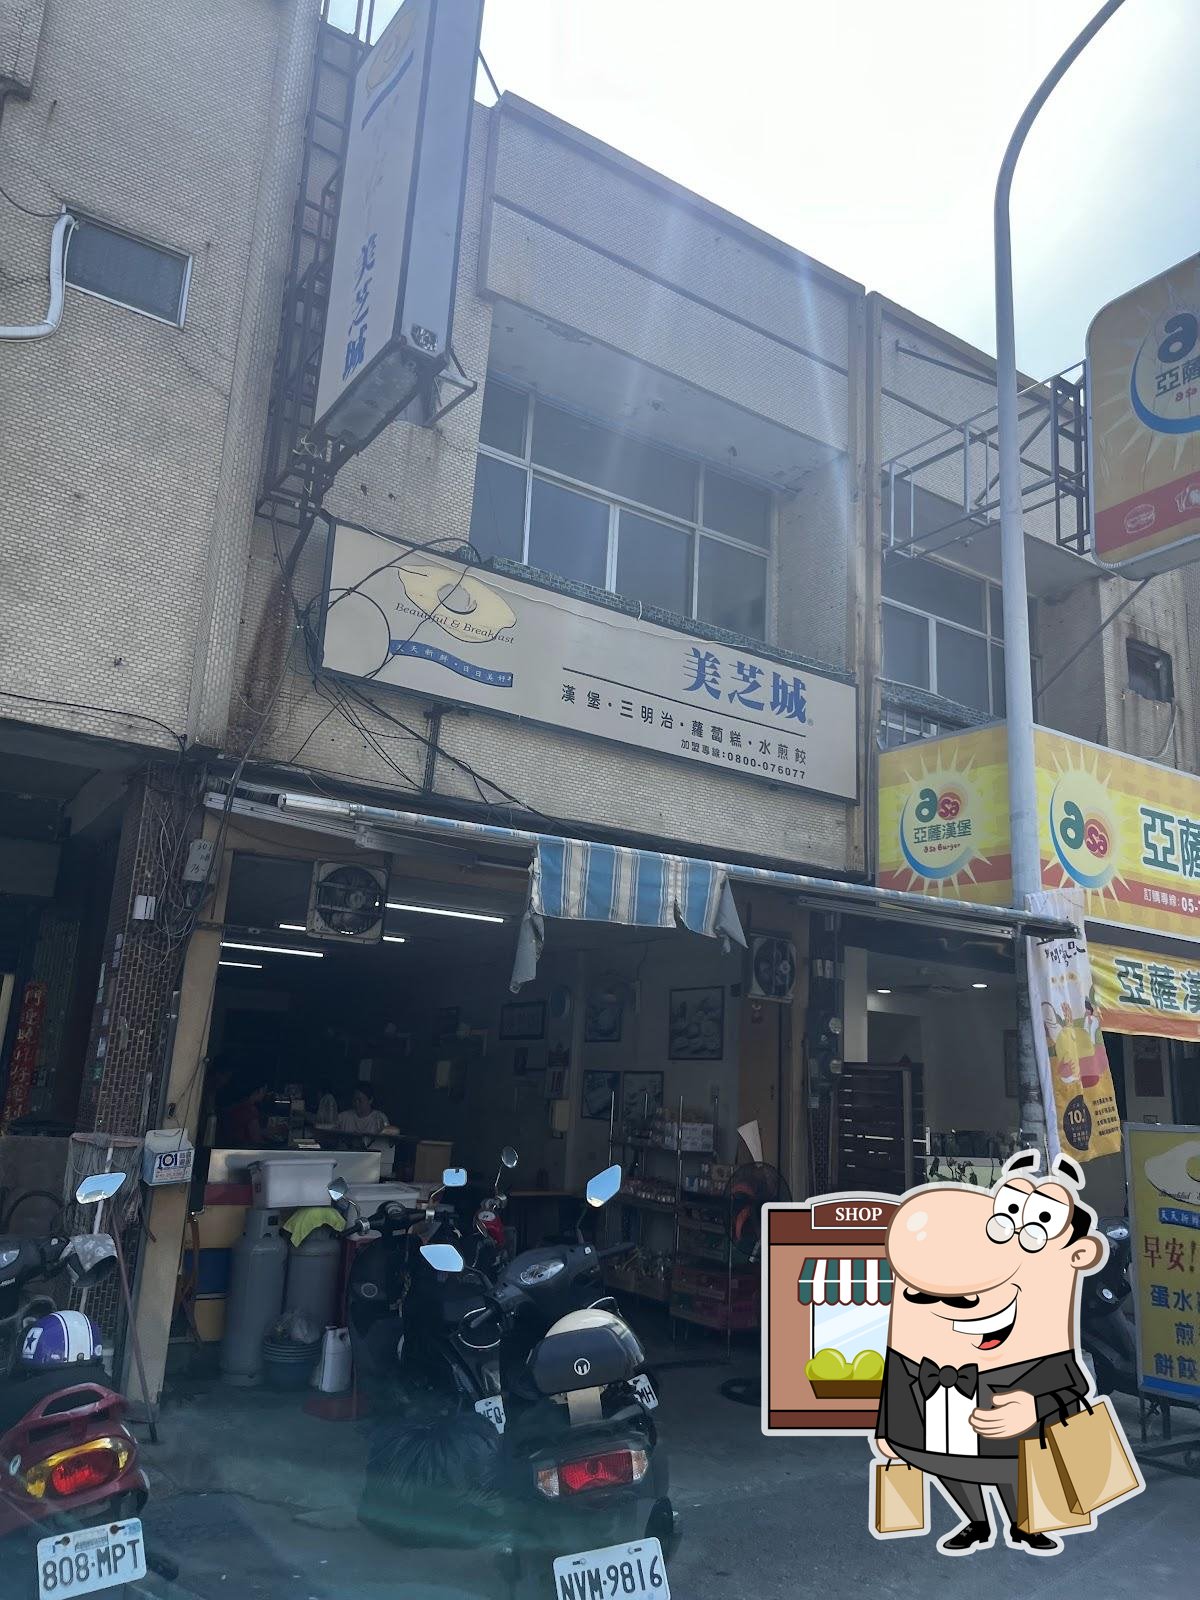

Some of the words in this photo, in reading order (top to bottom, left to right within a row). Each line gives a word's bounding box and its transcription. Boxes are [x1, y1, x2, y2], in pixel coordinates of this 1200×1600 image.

[395, 602, 448, 625] Beautful
[463, 623, 514, 644] Breakfast
[682, 647, 807, 724] 美芝城
[913, 819, 972, 844] 亞薩漢堡
